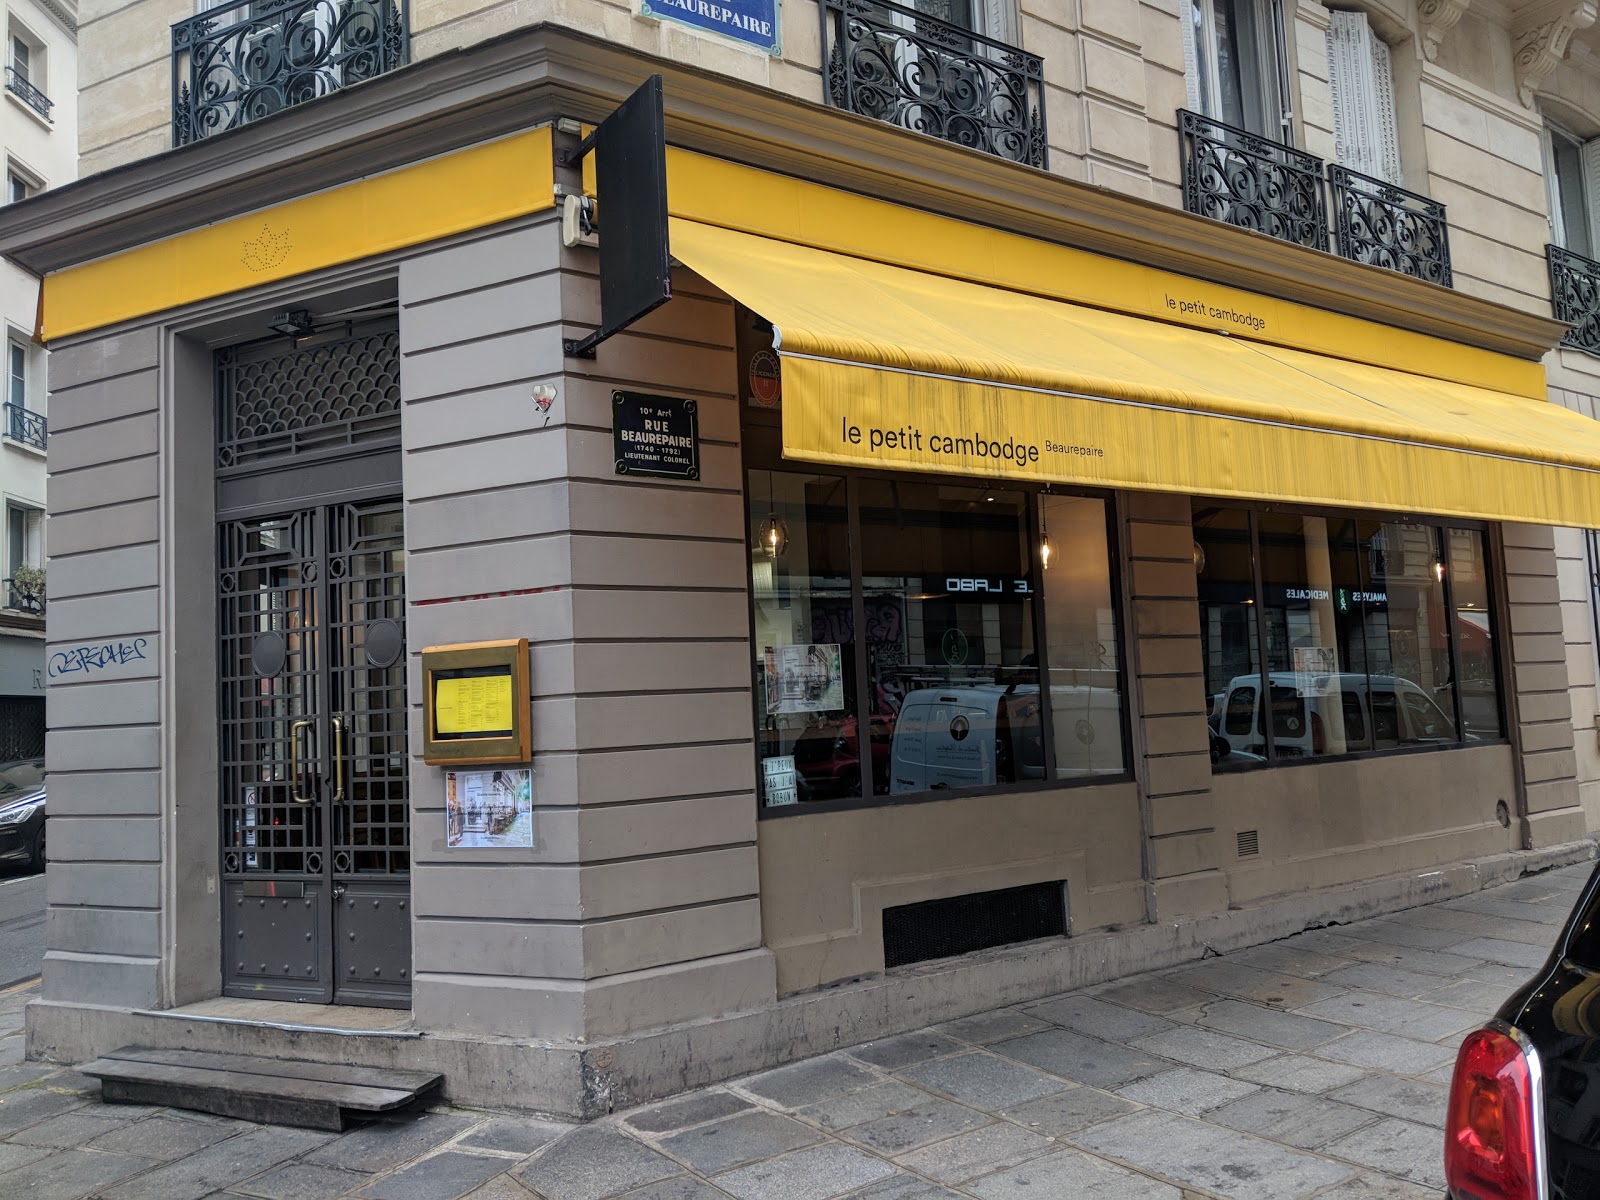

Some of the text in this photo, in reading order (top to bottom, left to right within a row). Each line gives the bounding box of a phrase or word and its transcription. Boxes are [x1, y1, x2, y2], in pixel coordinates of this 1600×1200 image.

[658, 0, 772, 37] AUREPAIRE
[1165, 293, 1265, 331] le petit cambodge
[645, 419, 669, 432] RUE
[621, 430, 692, 448] BEAUREPAIRE
[842, 416, 1104, 467] le petit cambodge Beaurepaire
[624, 452, 690, 465] LIEUTENANT COLONEL
[765, 777, 777, 789] PAS
